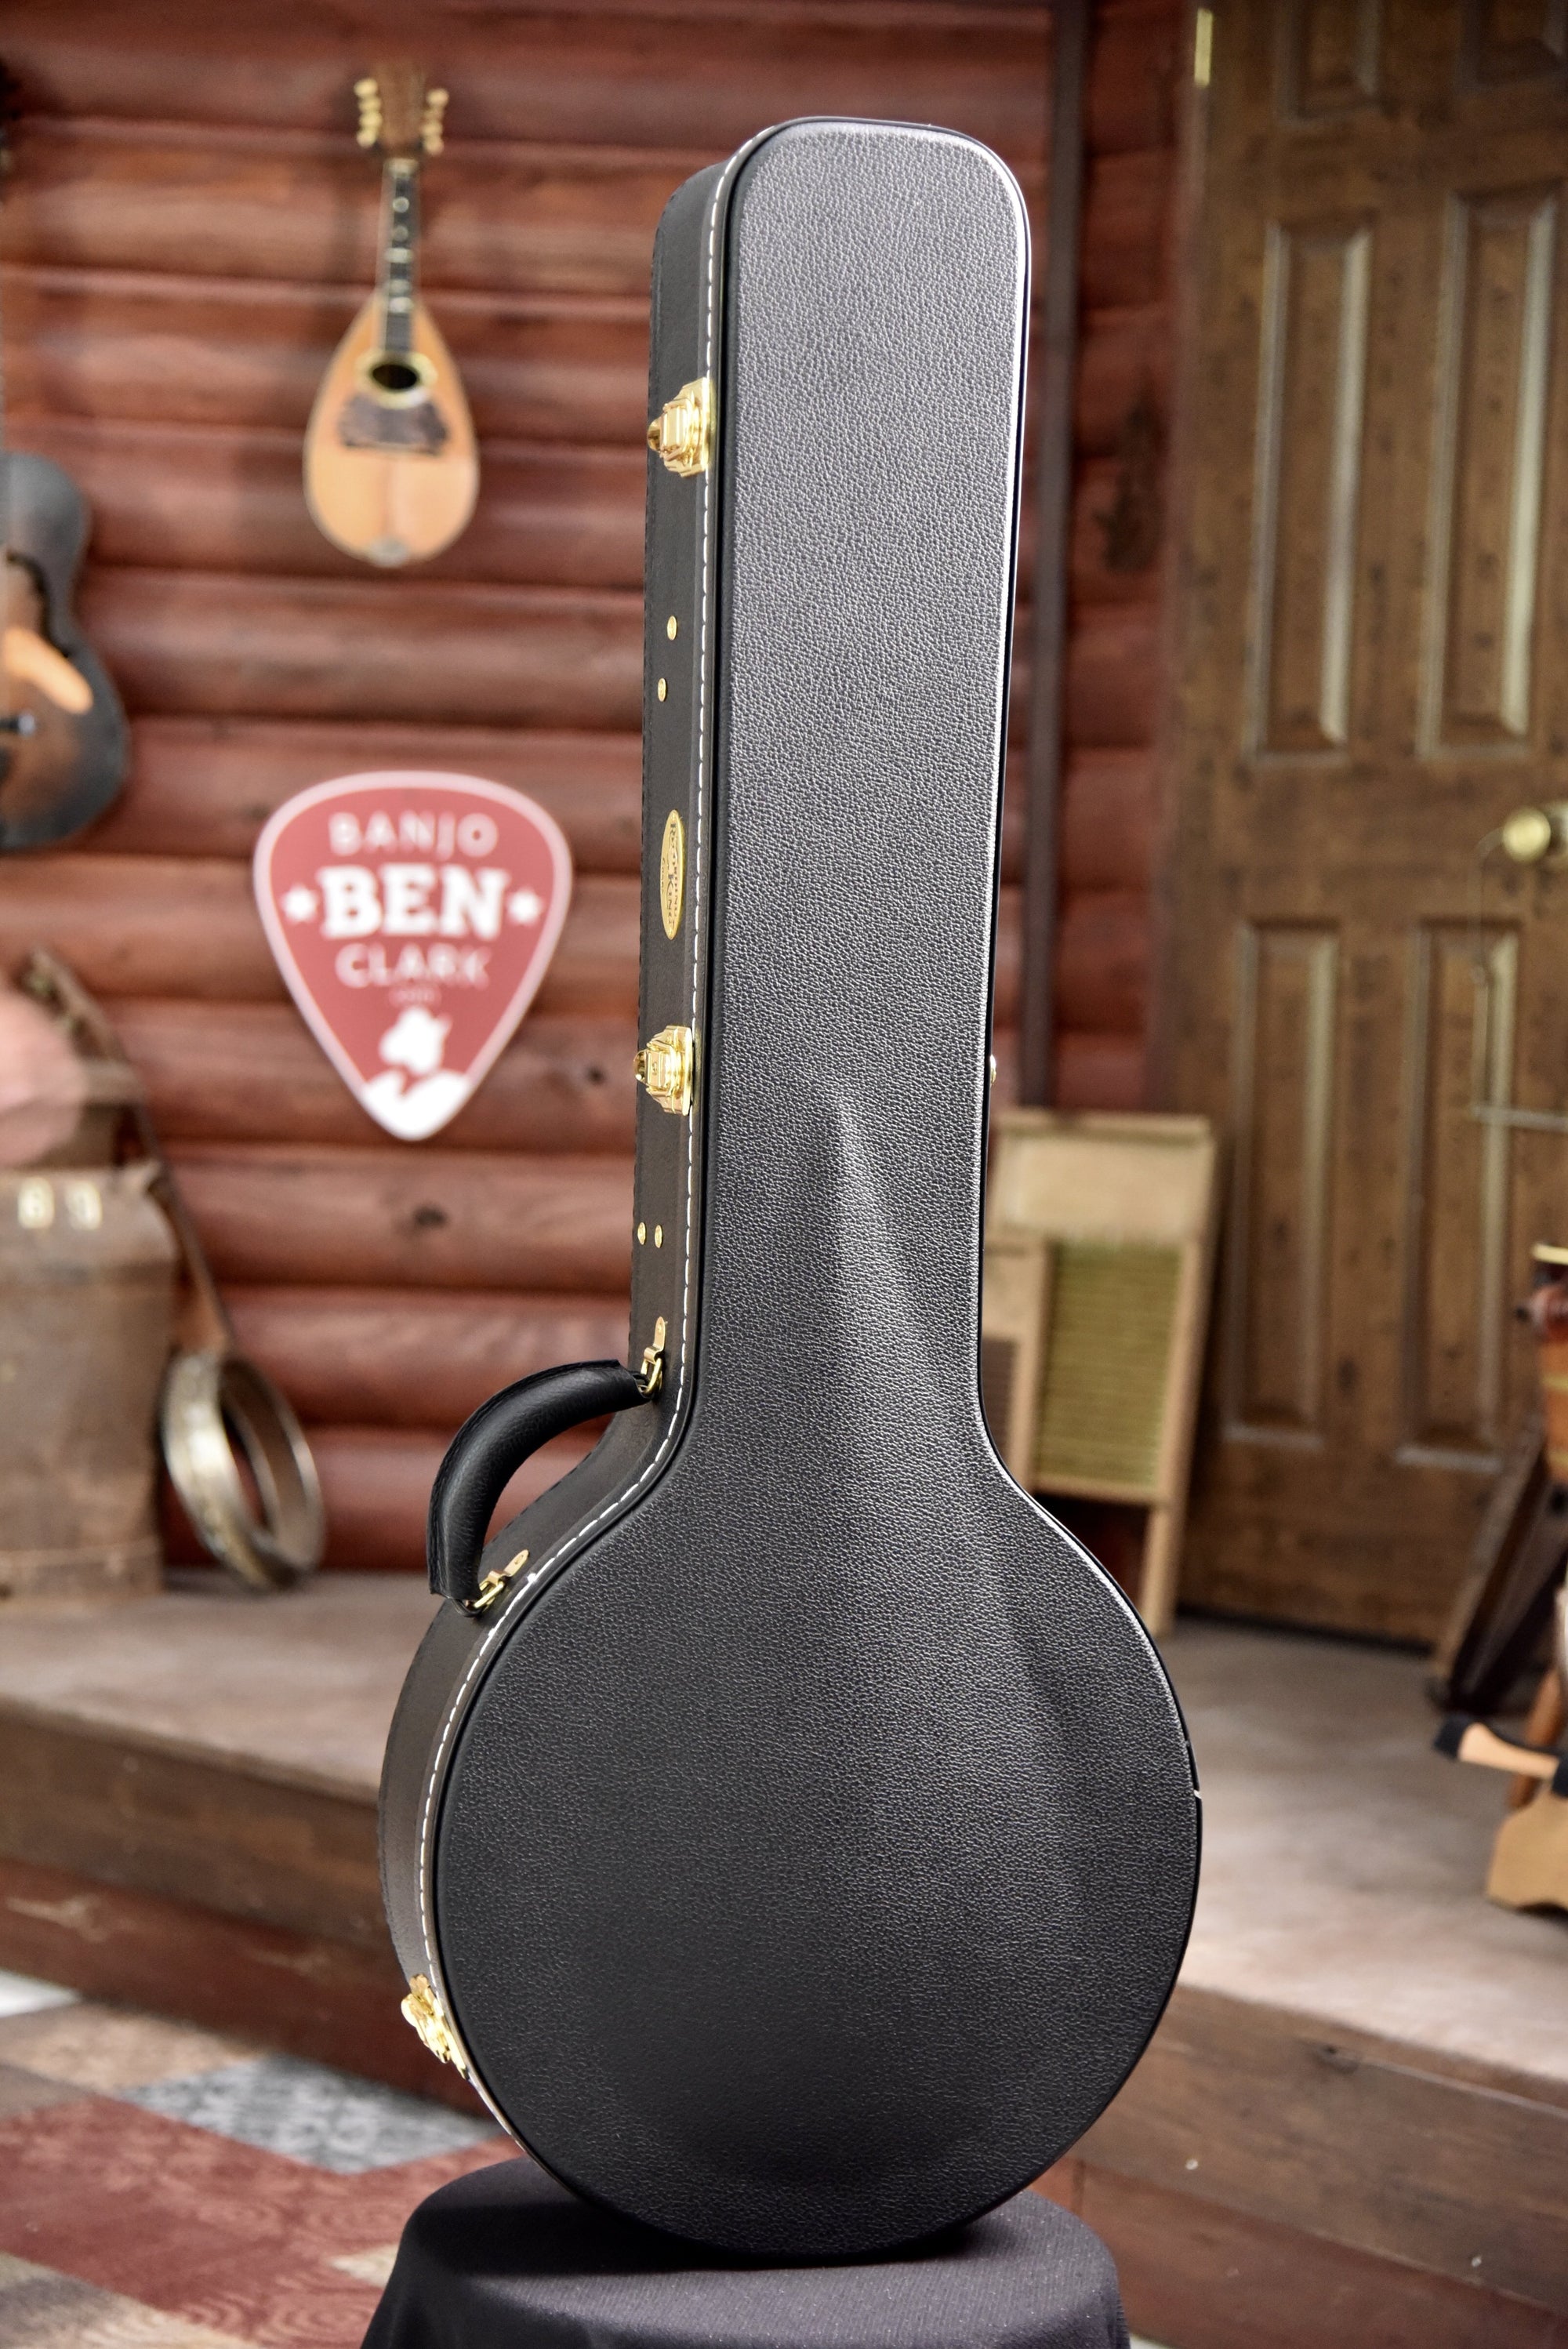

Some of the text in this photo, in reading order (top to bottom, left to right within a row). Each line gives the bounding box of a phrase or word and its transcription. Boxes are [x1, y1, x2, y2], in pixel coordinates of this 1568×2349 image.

[328, 811, 499, 859] BANJO
[317, 864, 512, 939] BEN
[335, 943, 492, 989] CLARK
